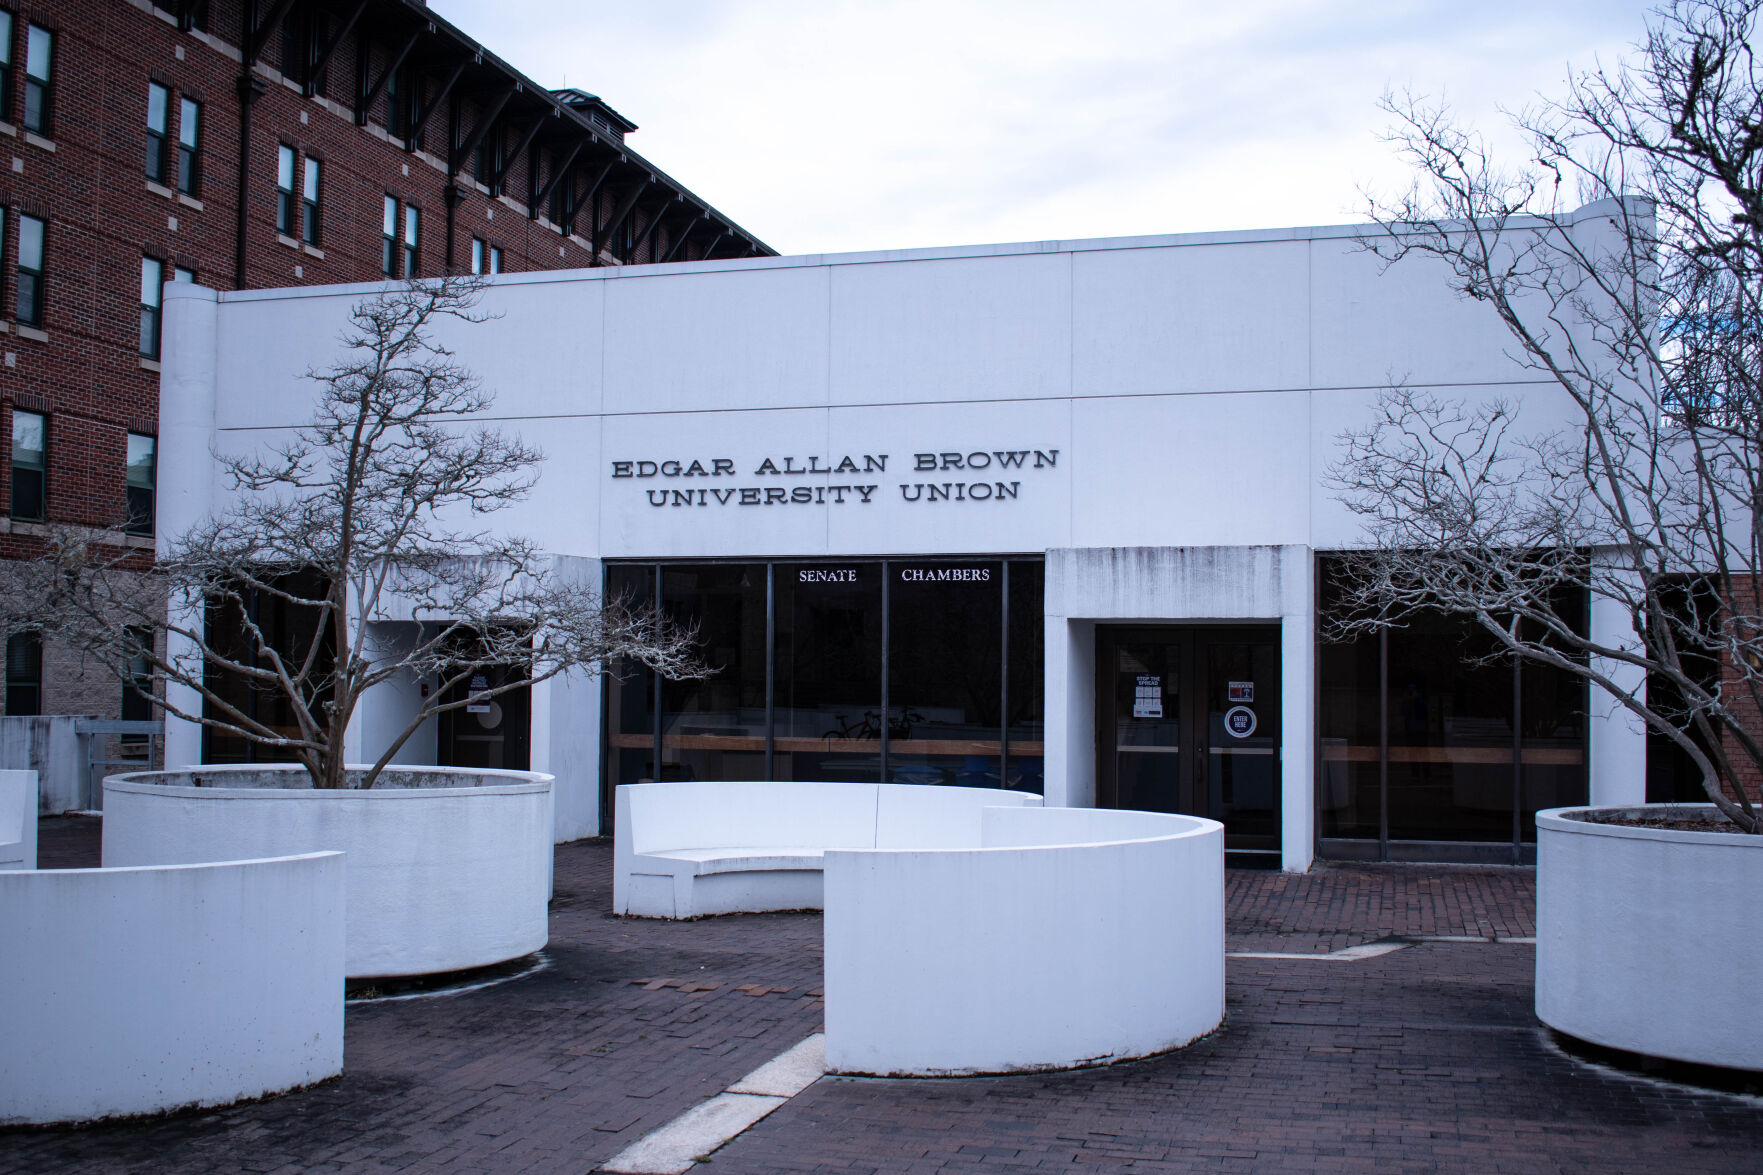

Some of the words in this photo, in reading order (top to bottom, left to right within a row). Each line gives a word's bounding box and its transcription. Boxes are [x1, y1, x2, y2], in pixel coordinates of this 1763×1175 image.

[612, 458, 736, 478] EDGAR
[754, 454, 889, 475] ALLAN
[913, 449, 1060, 471] BROWN
[646, 485, 878, 507] UNIVERSITY
[900, 481, 1021, 502] UNION
[799, 569, 857, 582] SENATE
[901, 568, 990, 582] CHAMBERS
